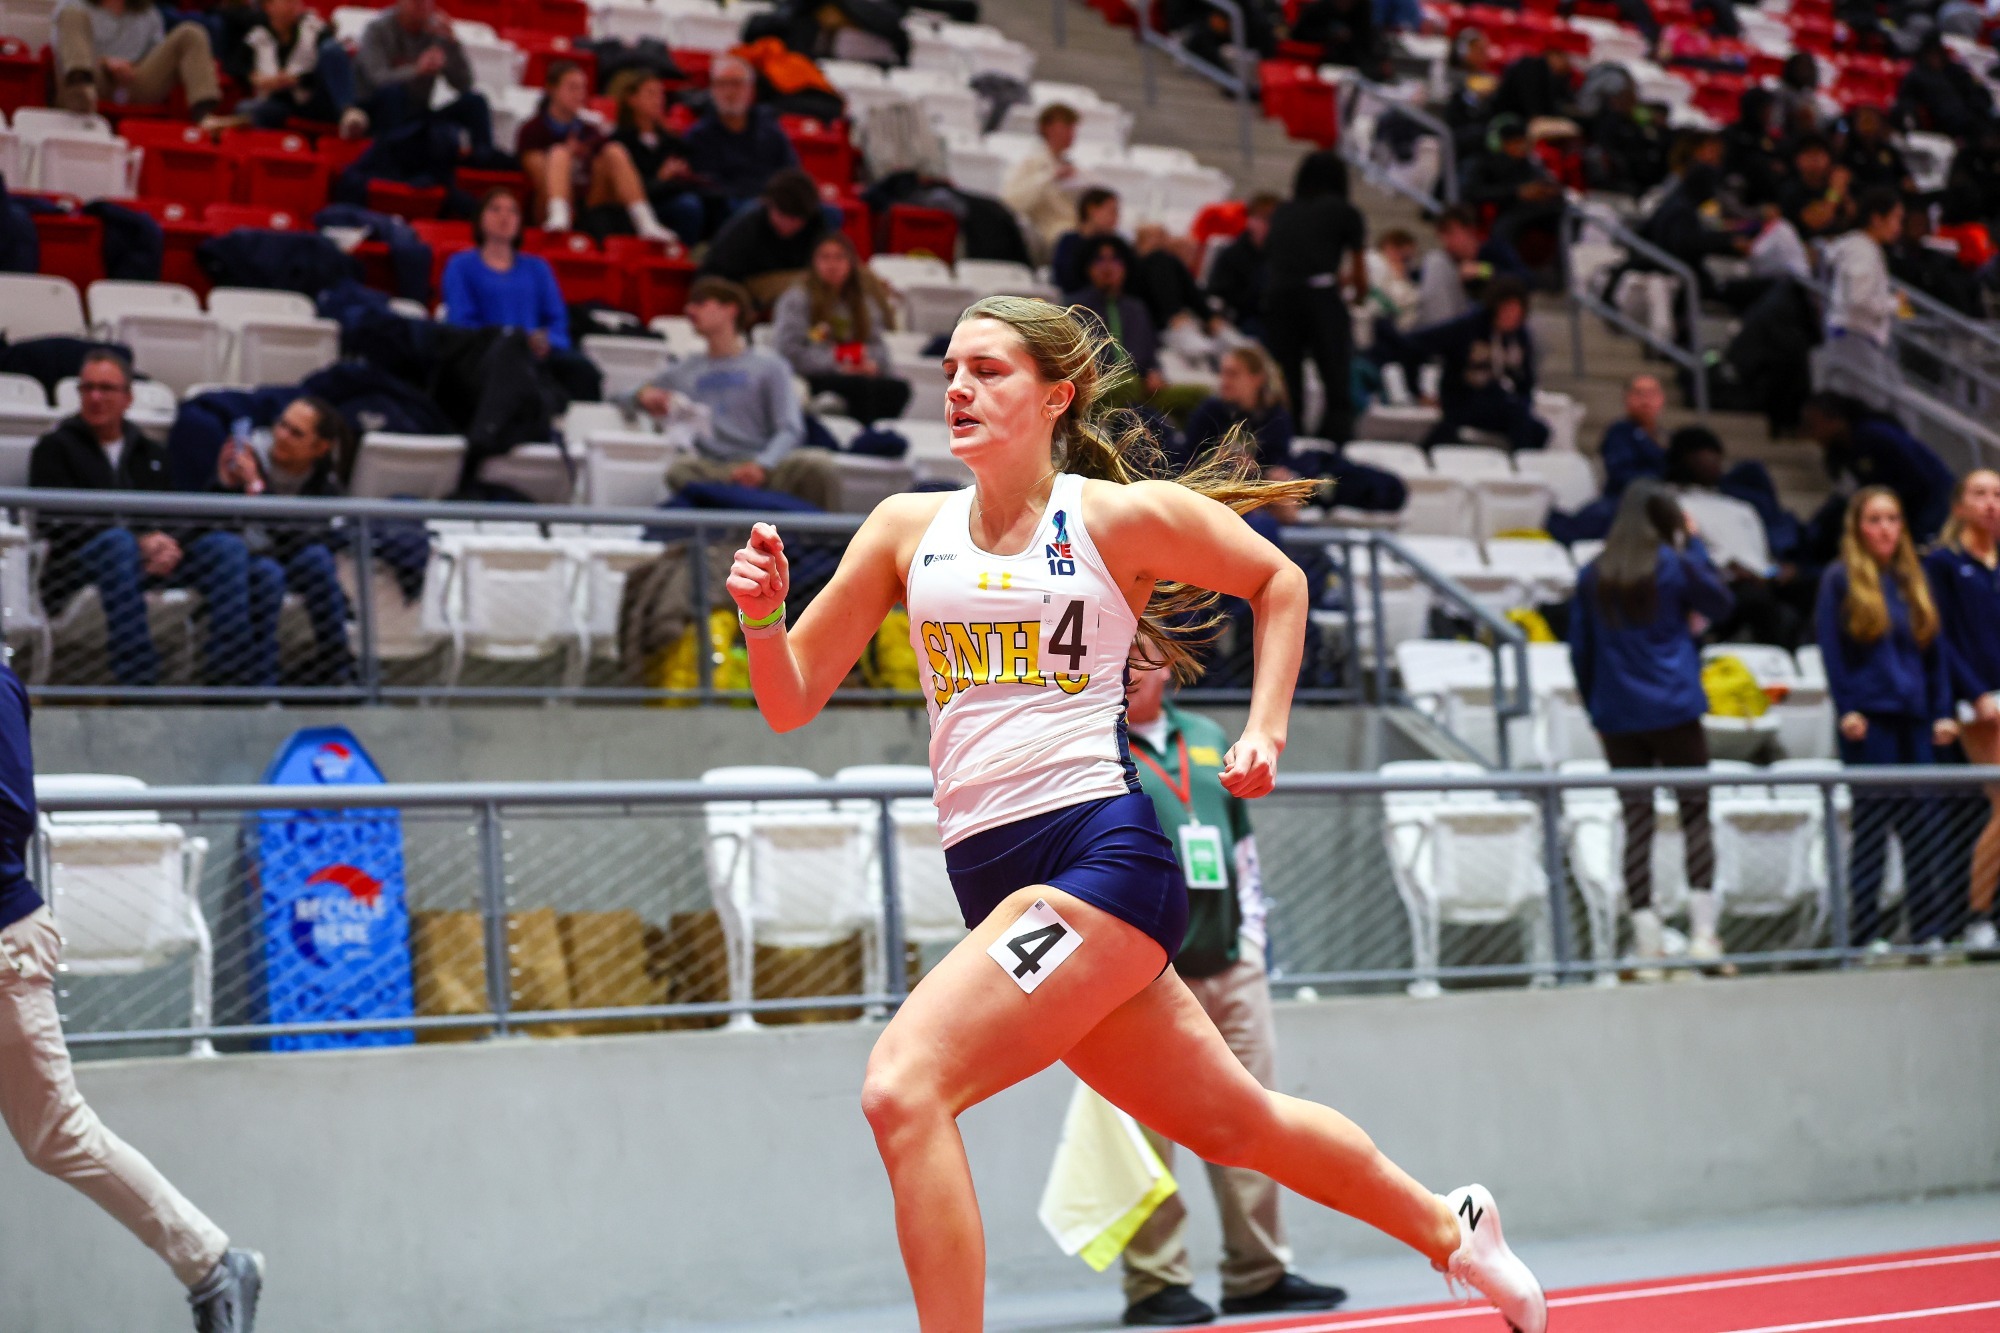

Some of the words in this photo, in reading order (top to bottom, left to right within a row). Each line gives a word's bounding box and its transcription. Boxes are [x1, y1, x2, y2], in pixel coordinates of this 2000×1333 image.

[933, 554, 957, 562] SNHU
[1046, 543, 1073, 558] NE
[1048, 559, 1076, 576] 10
[1048, 600, 1087, 671] 4
[921, 620, 1090, 710] SNH
[1006, 922, 1068, 979] 4
[1458, 1194, 1484, 1232] N
